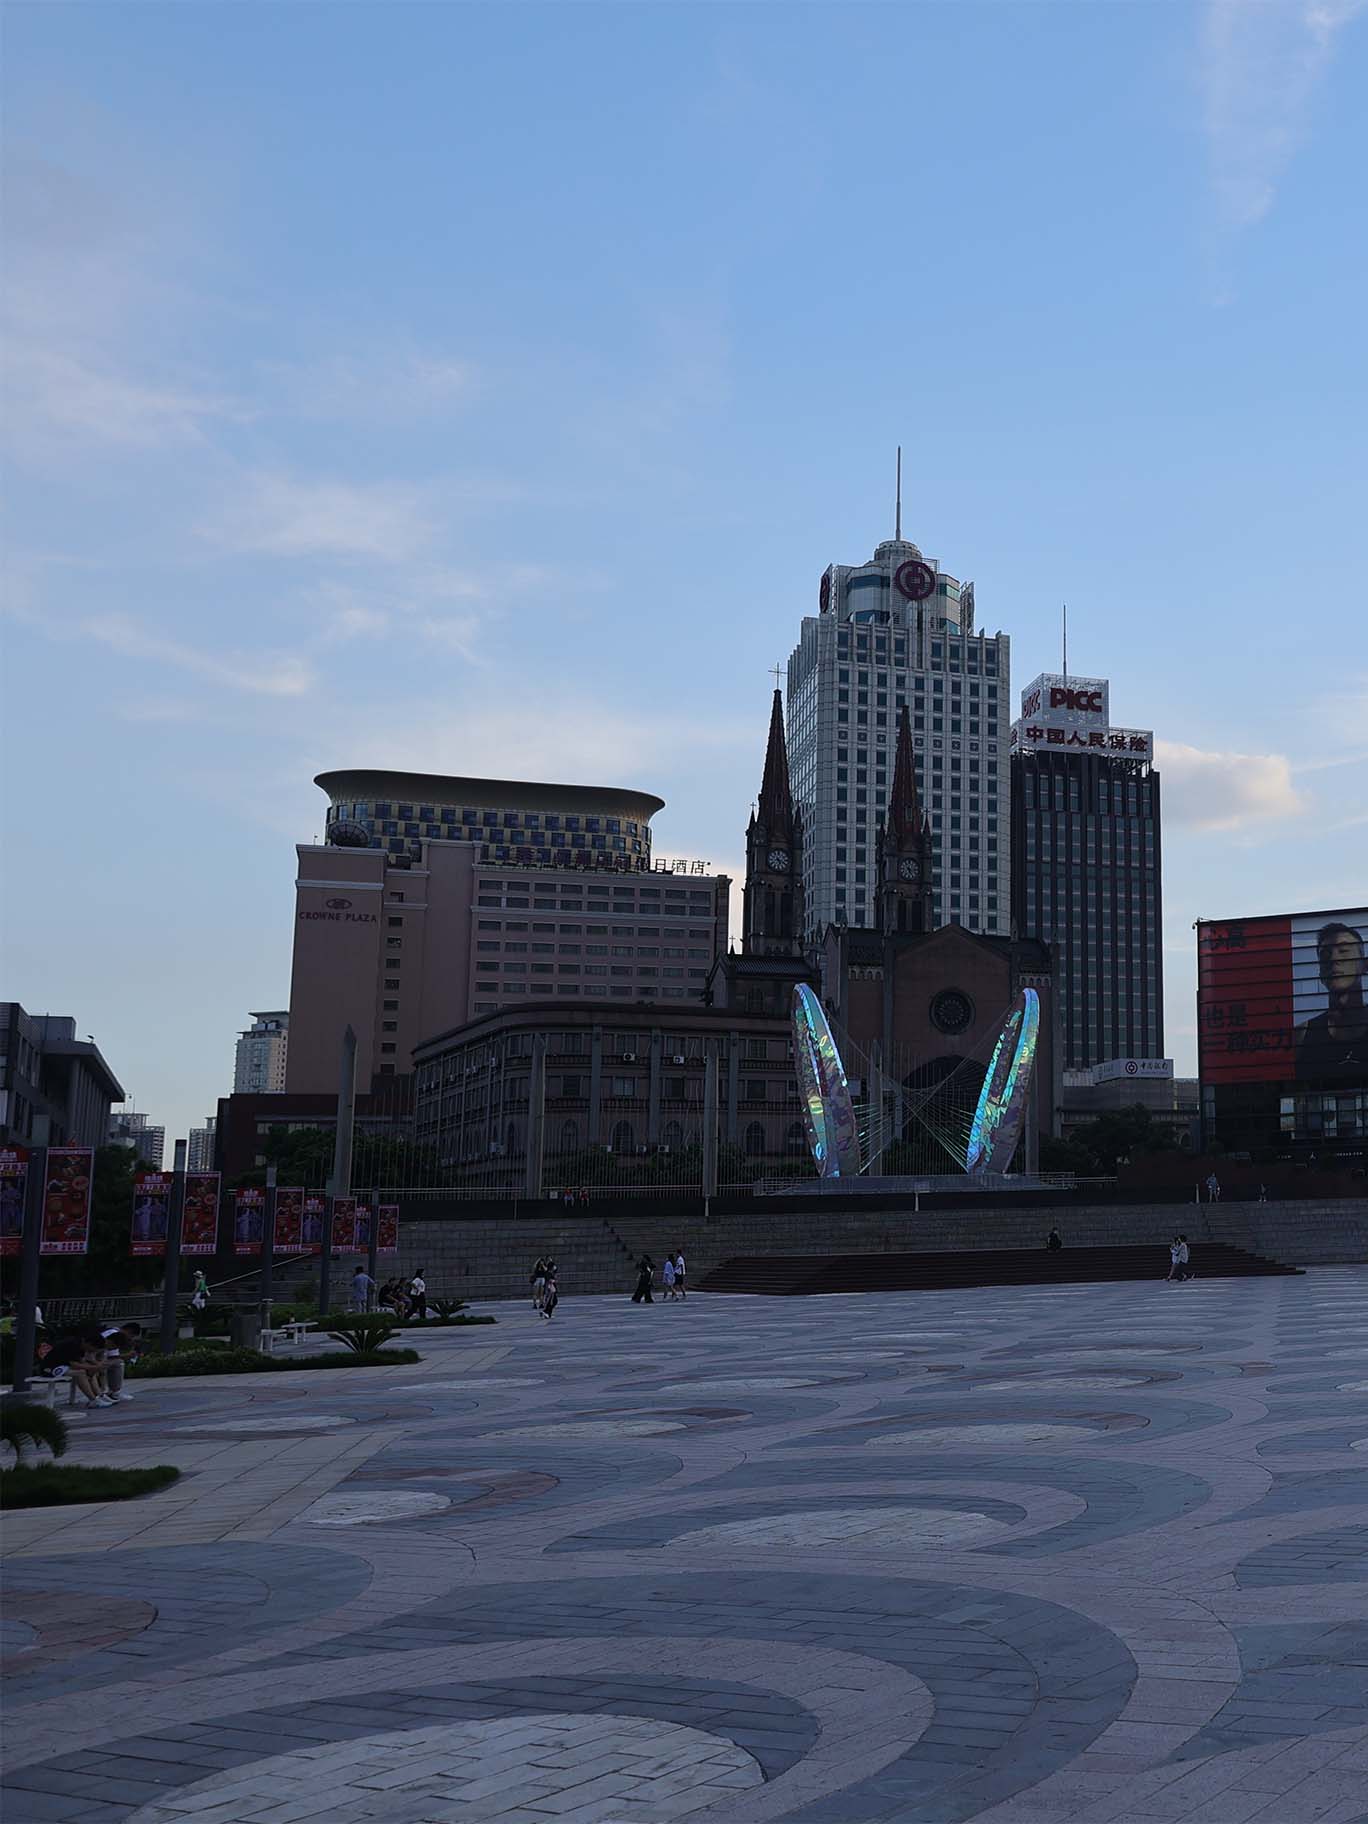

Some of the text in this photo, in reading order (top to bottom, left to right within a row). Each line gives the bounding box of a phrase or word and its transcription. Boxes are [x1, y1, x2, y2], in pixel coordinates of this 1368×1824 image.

[1050, 687, 1102, 713] PICC
[1026, 725, 1148, 752] 中国人民保险
[299, 911, 377, 923] CROWNE PLAZA
